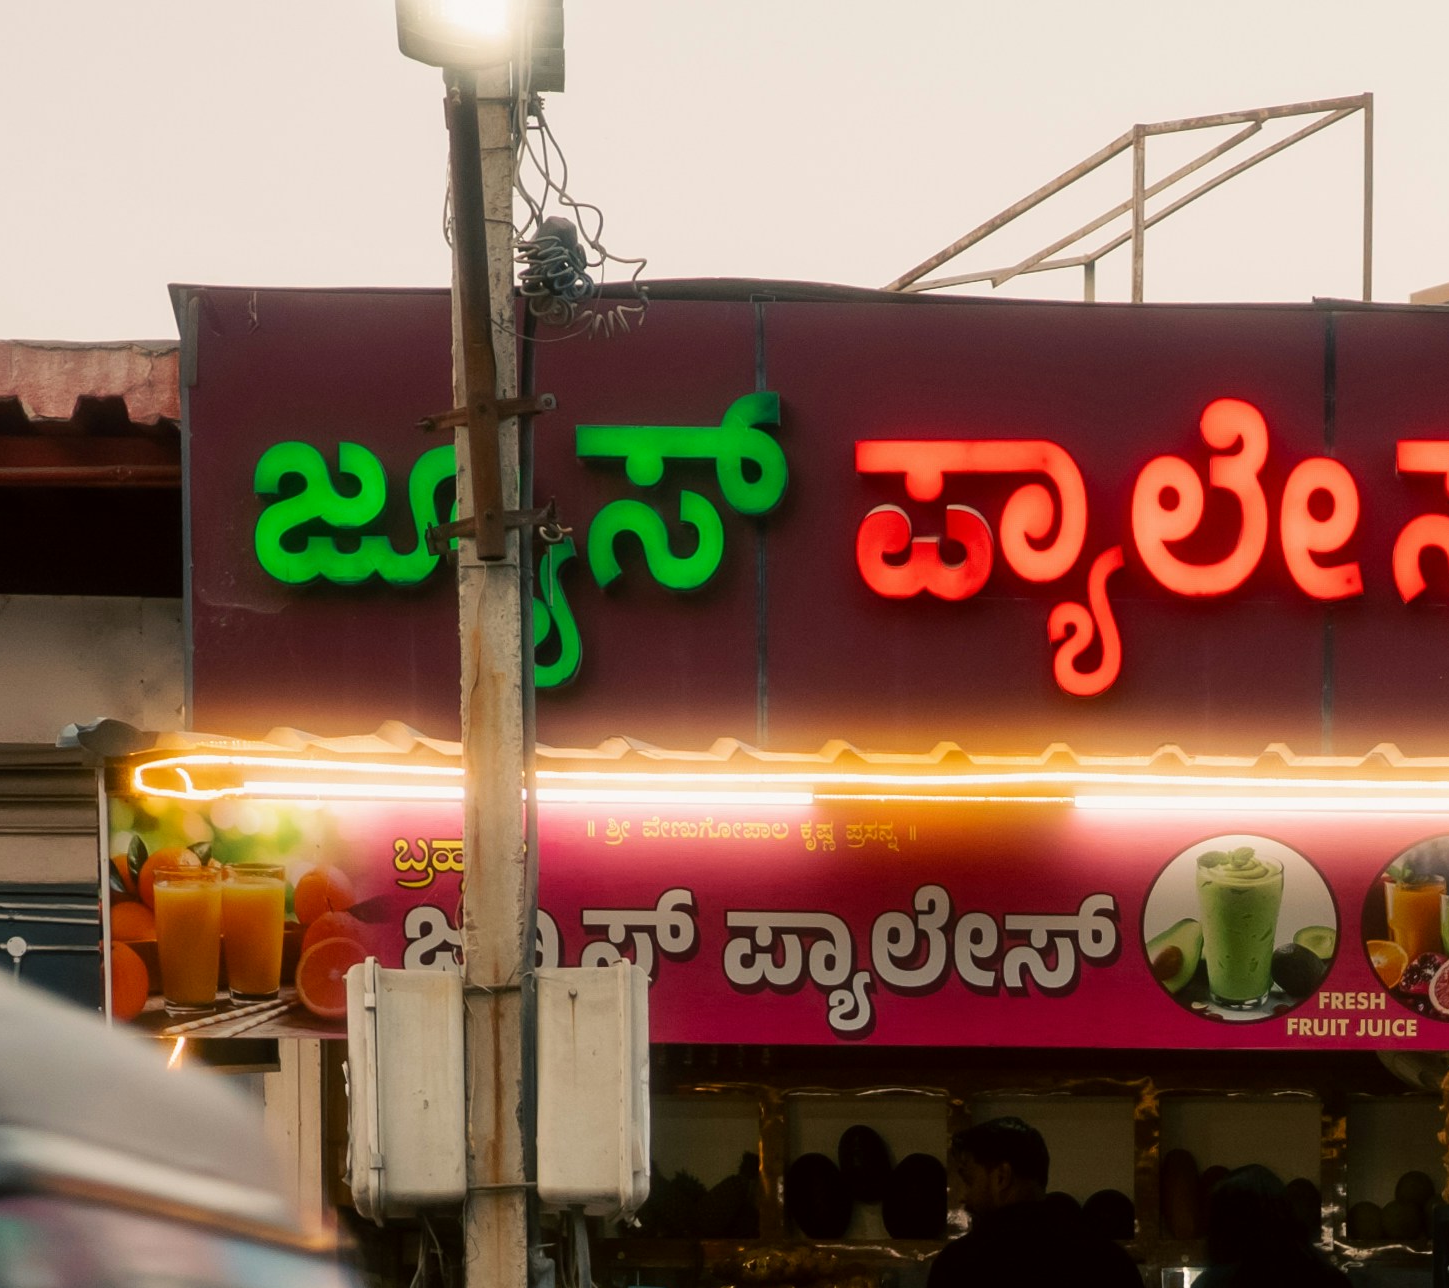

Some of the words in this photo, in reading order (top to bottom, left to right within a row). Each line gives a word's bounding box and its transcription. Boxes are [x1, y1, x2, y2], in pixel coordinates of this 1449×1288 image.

[724, 884, 1118, 1033] ಪ್ಯಾಲೇಸ್
[1319, 992, 1386, 1010] FRESH
[1287, 1018, 1349, 1036] FRUIT
[1356, 1019, 1417, 1037] JUICE
